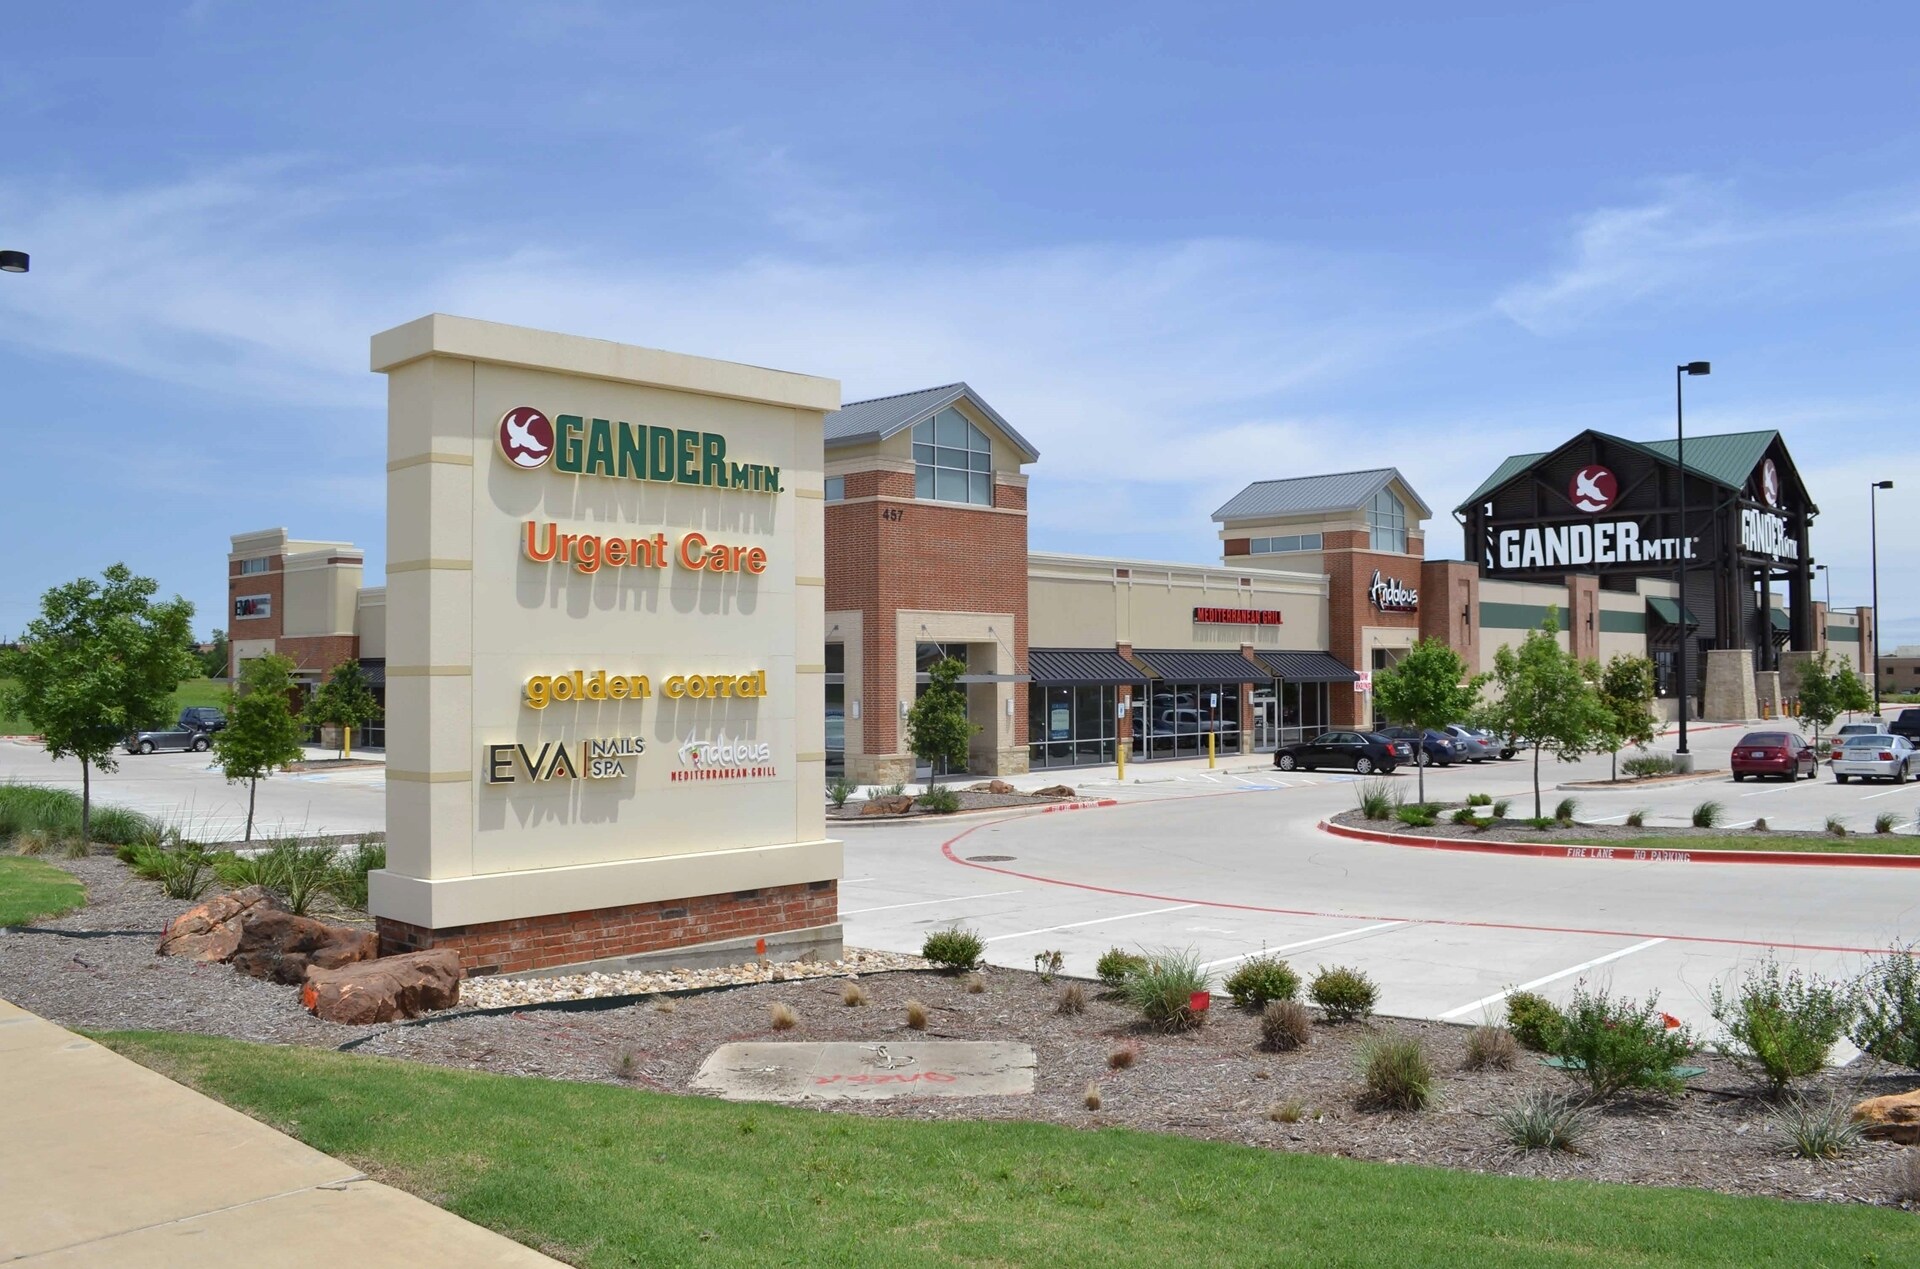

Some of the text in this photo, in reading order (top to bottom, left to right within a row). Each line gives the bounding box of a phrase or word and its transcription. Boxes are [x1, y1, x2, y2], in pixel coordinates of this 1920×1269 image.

[555, 413, 728, 488] GANDER
[525, 520, 767, 574] Urgent Care
[1500, 521, 1641, 569] GANDER
[1742, 508, 1784, 557] GANDER
[1371, 569, 1418, 609] Andalous
[1196, 607, 1283, 624] MEDITERRANEAN GRILL
[526, 670, 767, 709] golden corral
[489, 743, 578, 783] EVA
[592, 737, 645, 756] NAILS
[678, 727, 770, 769] Andalous
[593, 761, 625, 777] SPA
[671, 767, 776, 782] MEDITERRANEAN GRILL
[1567, 848, 1691, 862] FIRE LANE NO PARKING
